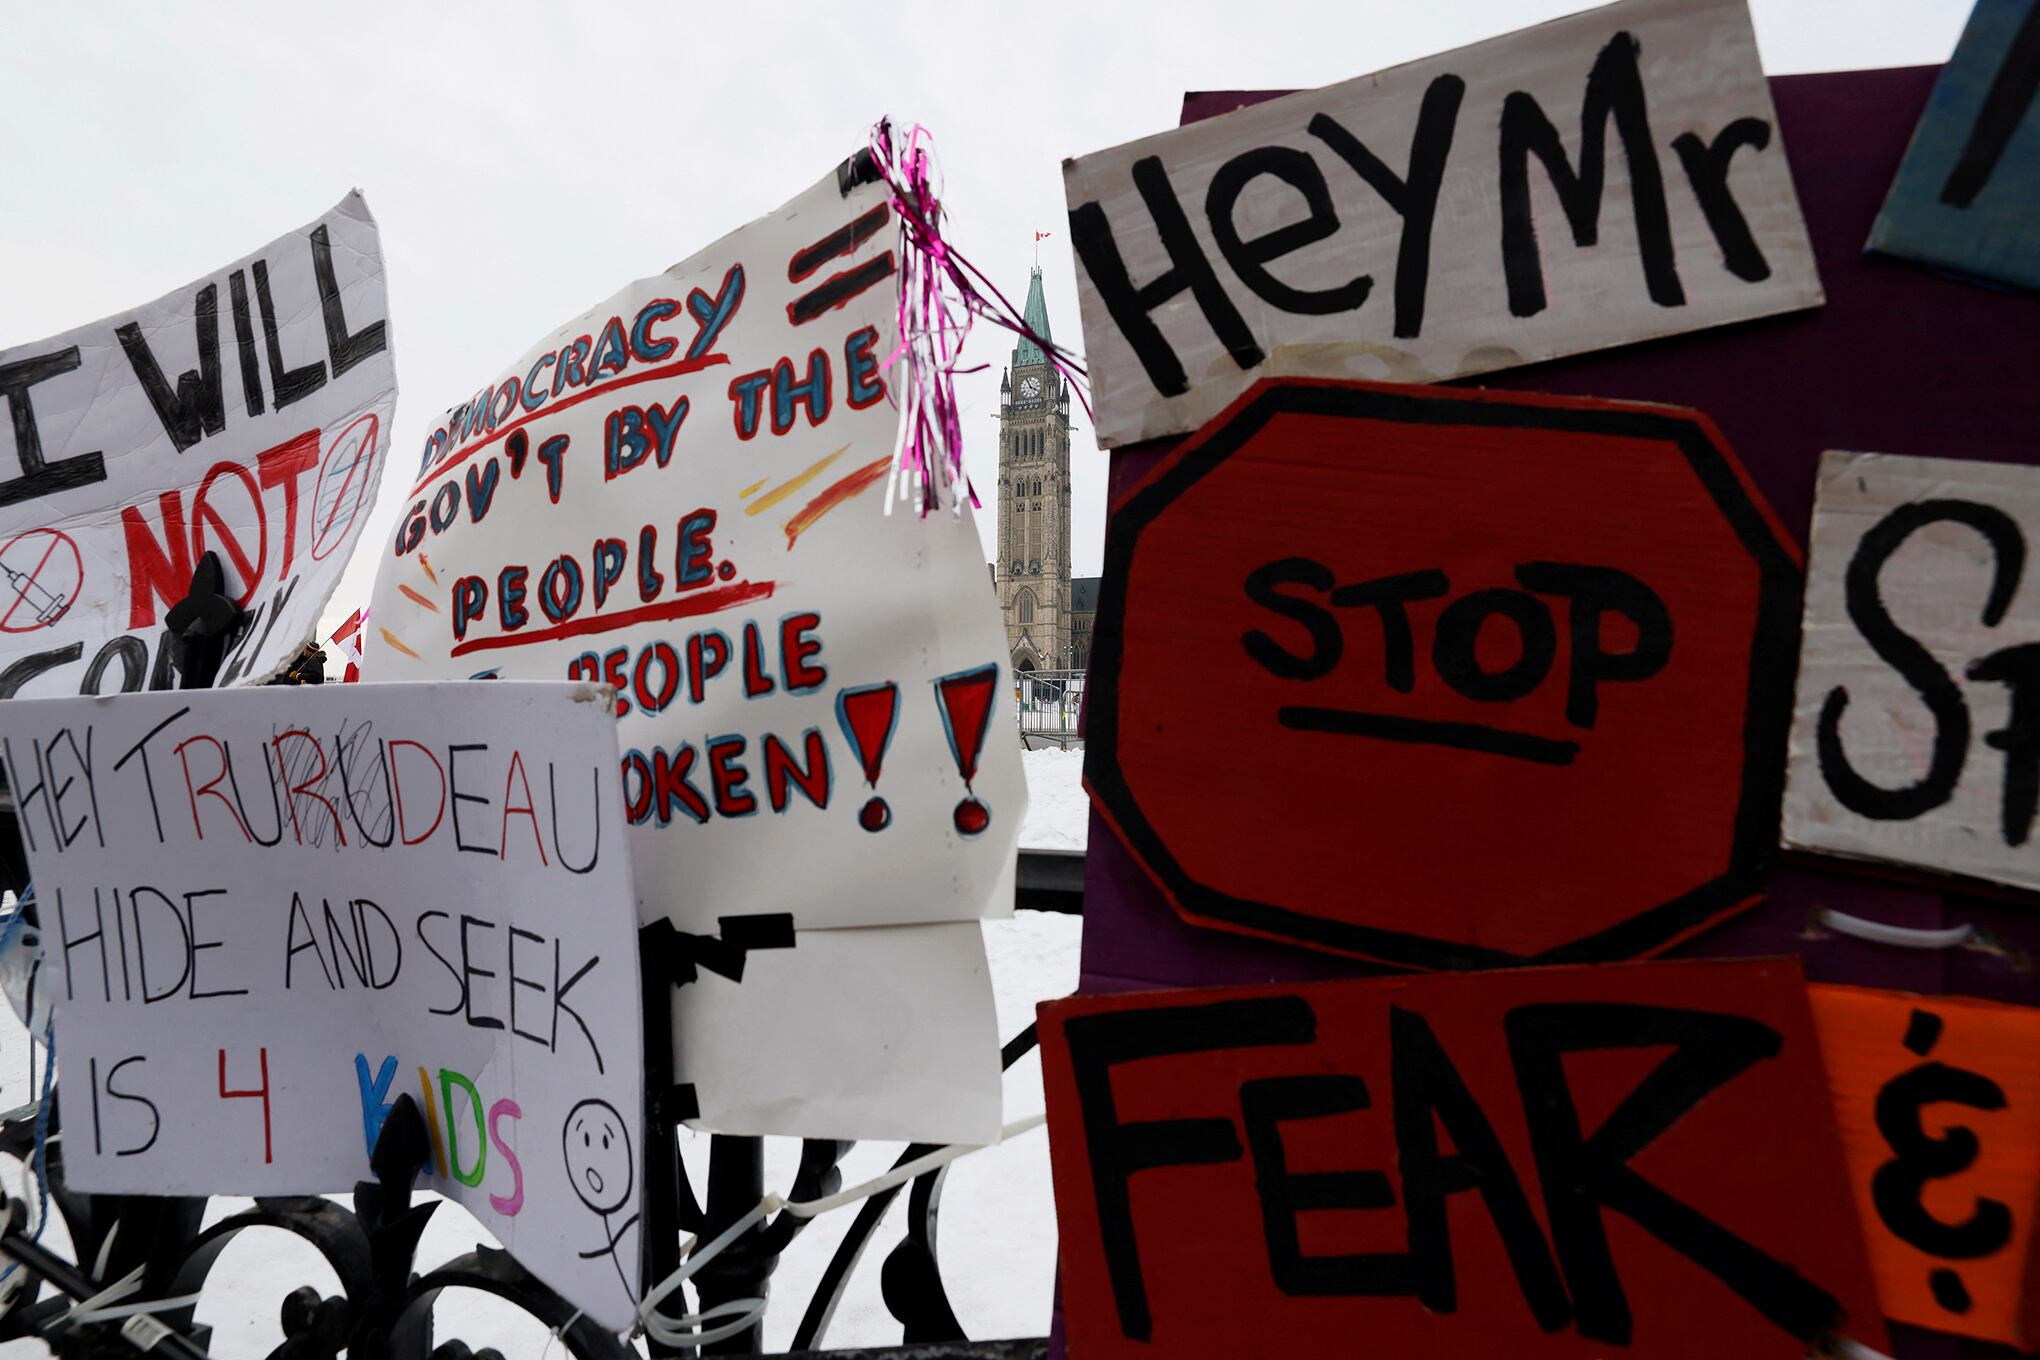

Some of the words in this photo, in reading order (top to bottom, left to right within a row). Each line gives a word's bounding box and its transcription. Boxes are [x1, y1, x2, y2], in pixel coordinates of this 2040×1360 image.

[1498, 30, 1772, 318] Mr
[0, 345, 107, 504] I
[115, 223, 387, 453] WILL
[395, 427, 570, 557] GOV'T
[604, 395, 690, 483] BY
[727, 323, 887, 440] THE
[415, 262, 746, 483] DEMOCRACY
[121, 427, 322, 630] NOT
[451, 508, 738, 642] PEOPLE.
[1241, 556, 1673, 729] STOP
[3, 725, 105, 853] HEY
[56, 886, 248, 1004] HIDE
[286, 891, 402, 991] AND
[416, 910, 605, 1075] SEEK
[89, 1056, 161, 1157] IS
[218, 1047, 273, 1164] 4
[355, 1053, 524, 1217] KIDS
[1063, 995, 1848, 1347] FEAR
